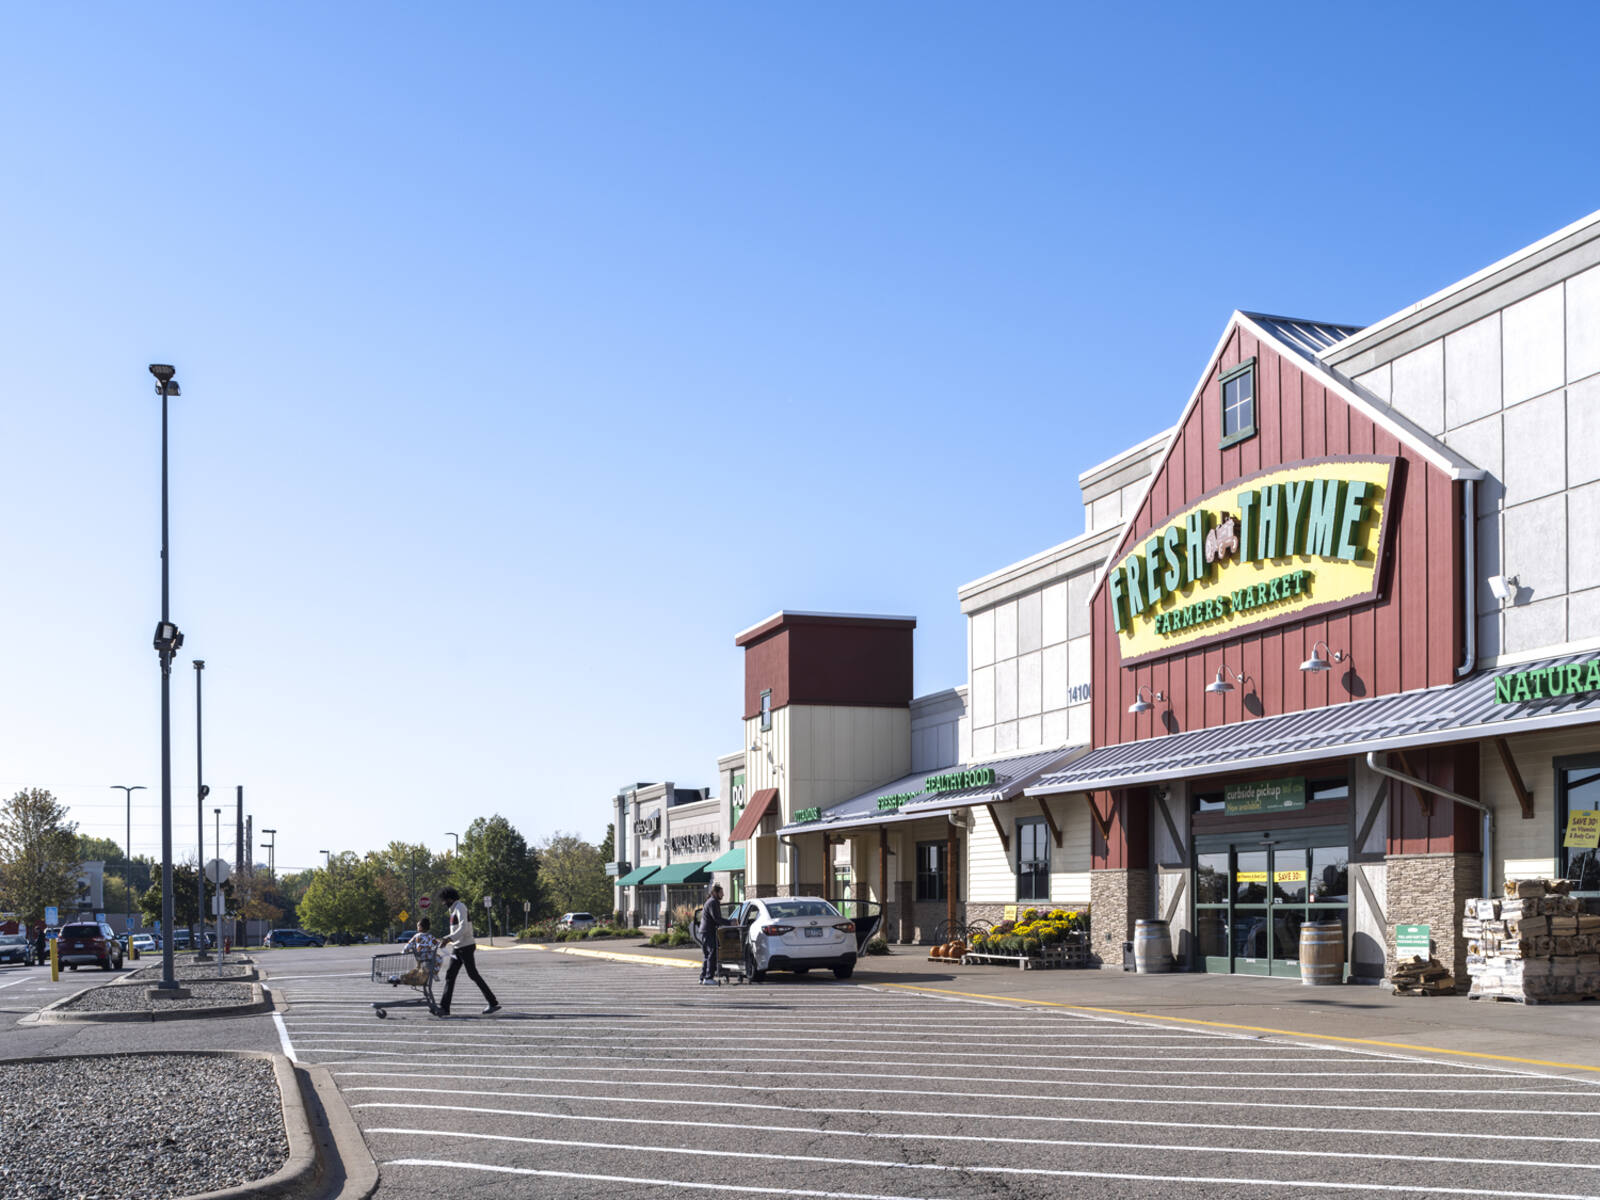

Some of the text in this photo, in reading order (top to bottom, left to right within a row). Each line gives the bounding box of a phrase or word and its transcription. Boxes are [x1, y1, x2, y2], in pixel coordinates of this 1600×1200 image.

[1109, 479, 1367, 633] FRESH THYME
[1154, 570, 1304, 634] FARMERS MARKET
[926, 768, 989, 793] HEALTHY FOOD
[1227, 786, 1255, 800] curbside
[1256, 784, 1281, 801] pickup
[878, 794, 898, 810] FRESH
[1572, 817, 1587, 825] SAVE
[1279, 871, 1291, 881] SAVE
